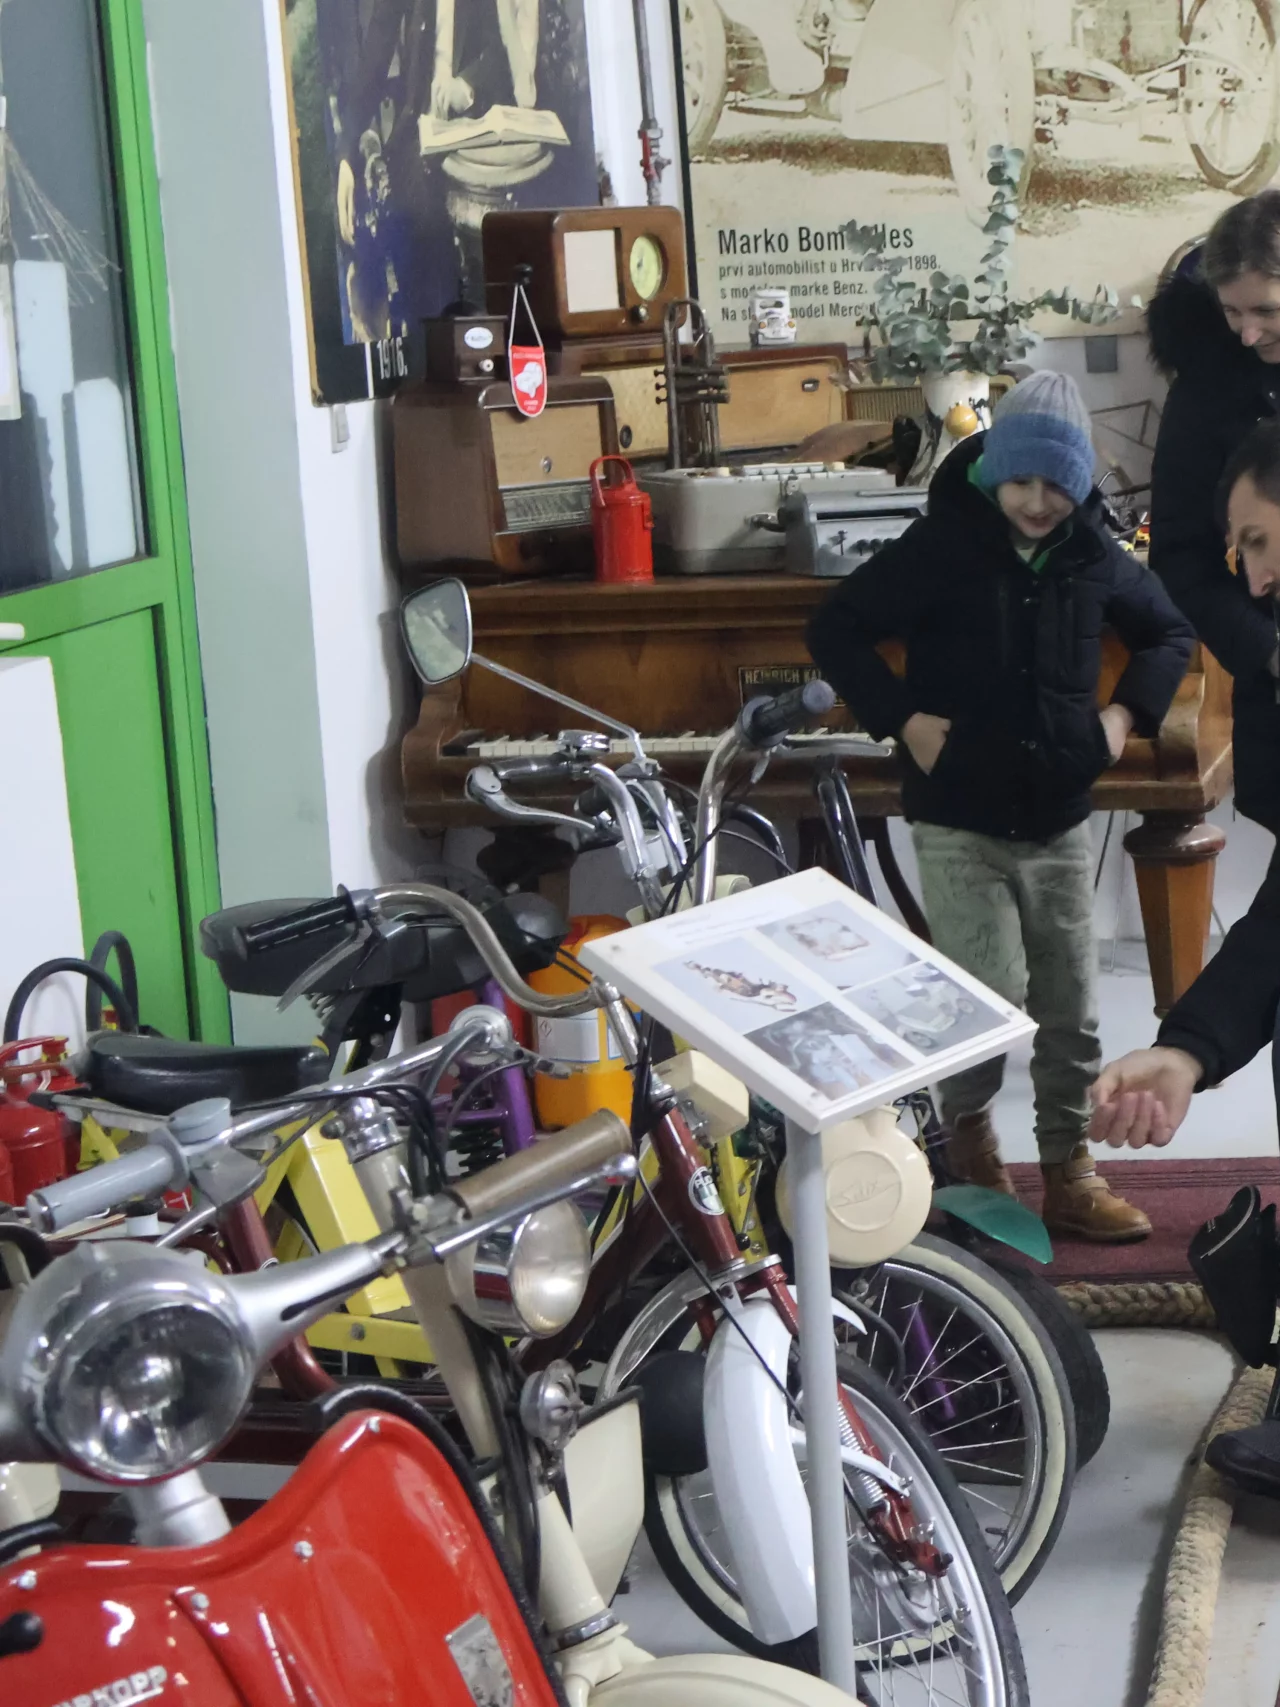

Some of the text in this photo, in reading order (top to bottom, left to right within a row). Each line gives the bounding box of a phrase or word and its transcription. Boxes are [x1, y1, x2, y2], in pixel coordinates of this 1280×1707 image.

[718, 228, 789, 255] Marko
[719, 262, 744, 281] prvi
[748, 259, 825, 277] automobilist
[830, 262, 837, 273] u
[908, 255, 941, 270] 1898.
[720, 287, 727, 299] s
[790, 281, 829, 298] marke
[834, 281, 868, 295] Benz.
[721, 307, 737, 321] Na
